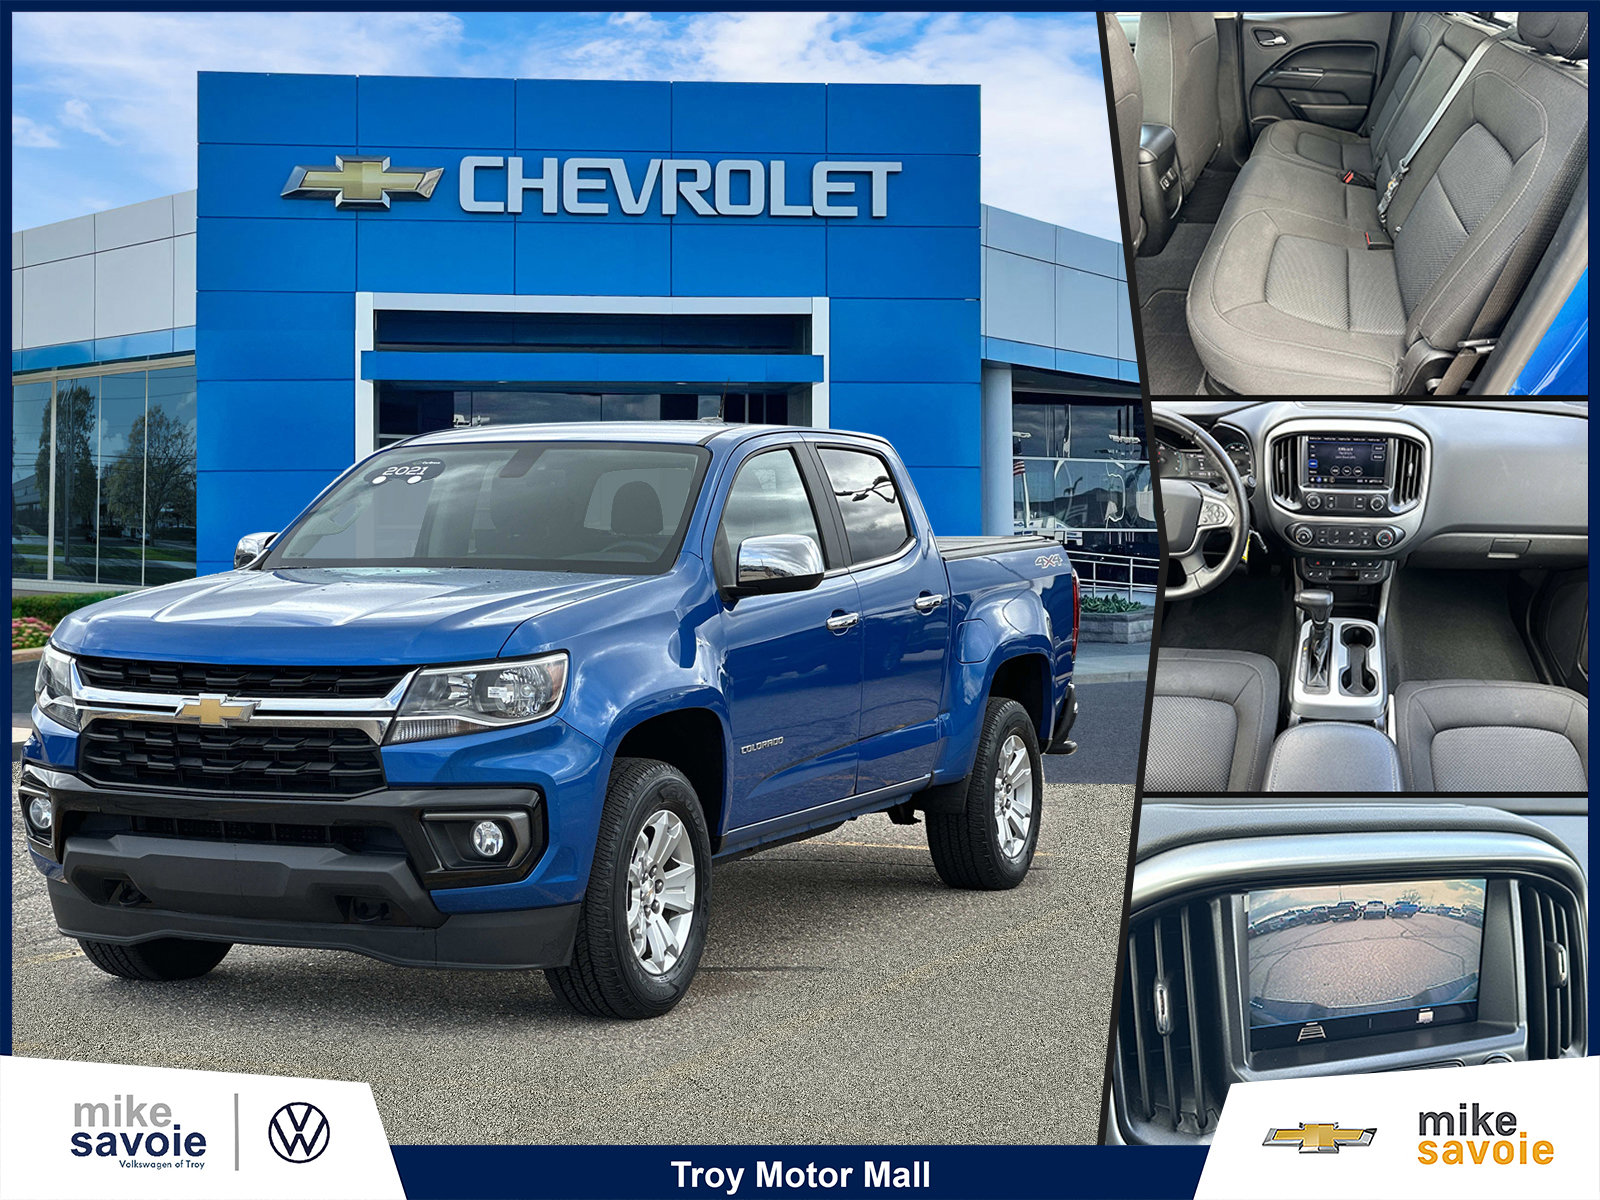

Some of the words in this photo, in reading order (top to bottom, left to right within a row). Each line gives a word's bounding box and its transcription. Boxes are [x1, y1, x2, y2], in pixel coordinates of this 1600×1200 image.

[459, 156, 903, 218] CHEVROLET
[382, 466, 429, 476] 2021
[741, 736, 784, 754] COLORADO
